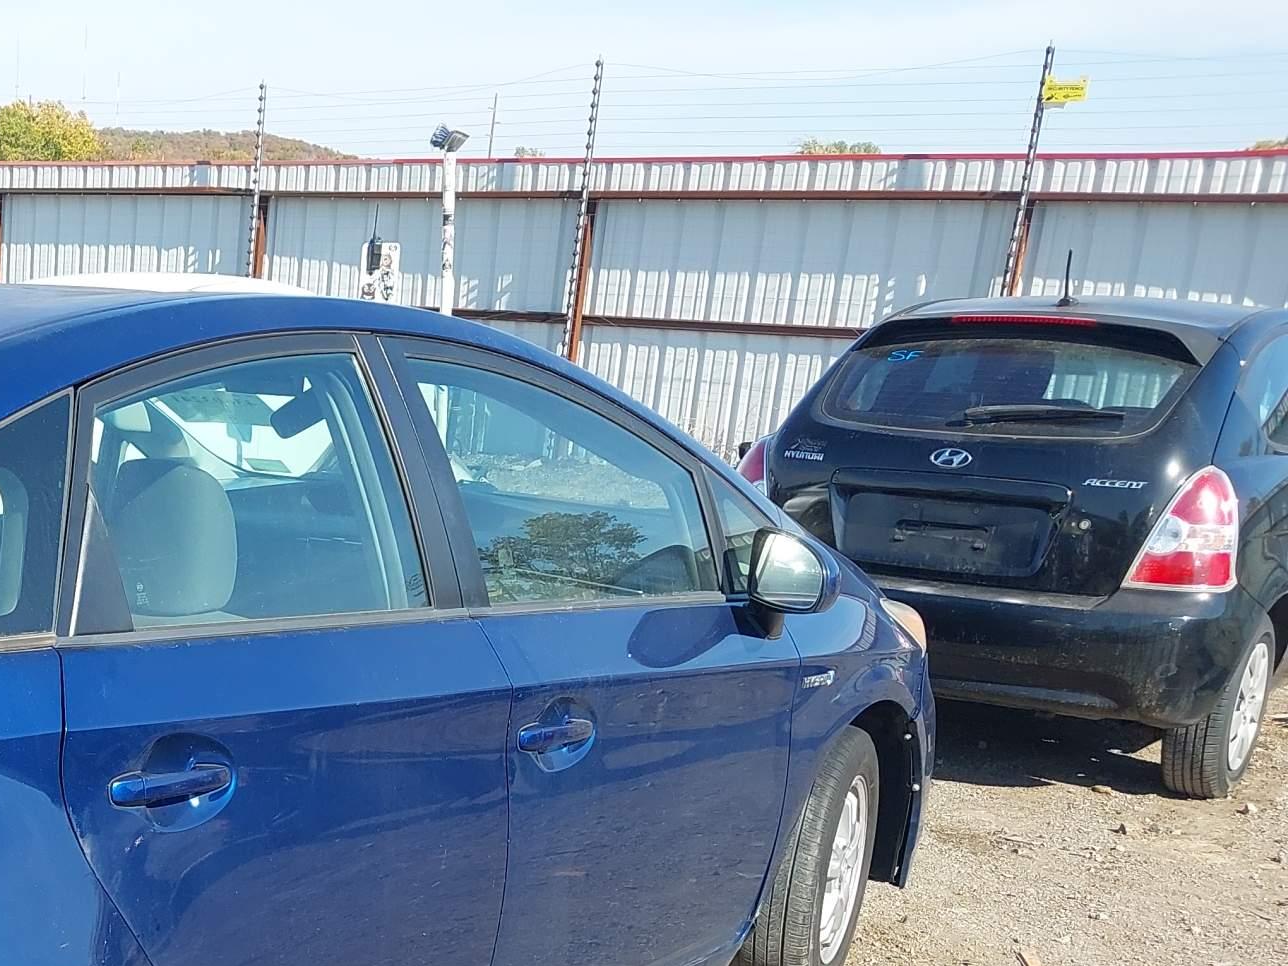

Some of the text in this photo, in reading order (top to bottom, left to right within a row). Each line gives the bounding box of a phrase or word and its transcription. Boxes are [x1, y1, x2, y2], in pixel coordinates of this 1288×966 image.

[887, 349, 925, 361] SF
[784, 450, 825, 461] HYUNDAI
[1081, 478, 1149, 489] ACCENT
